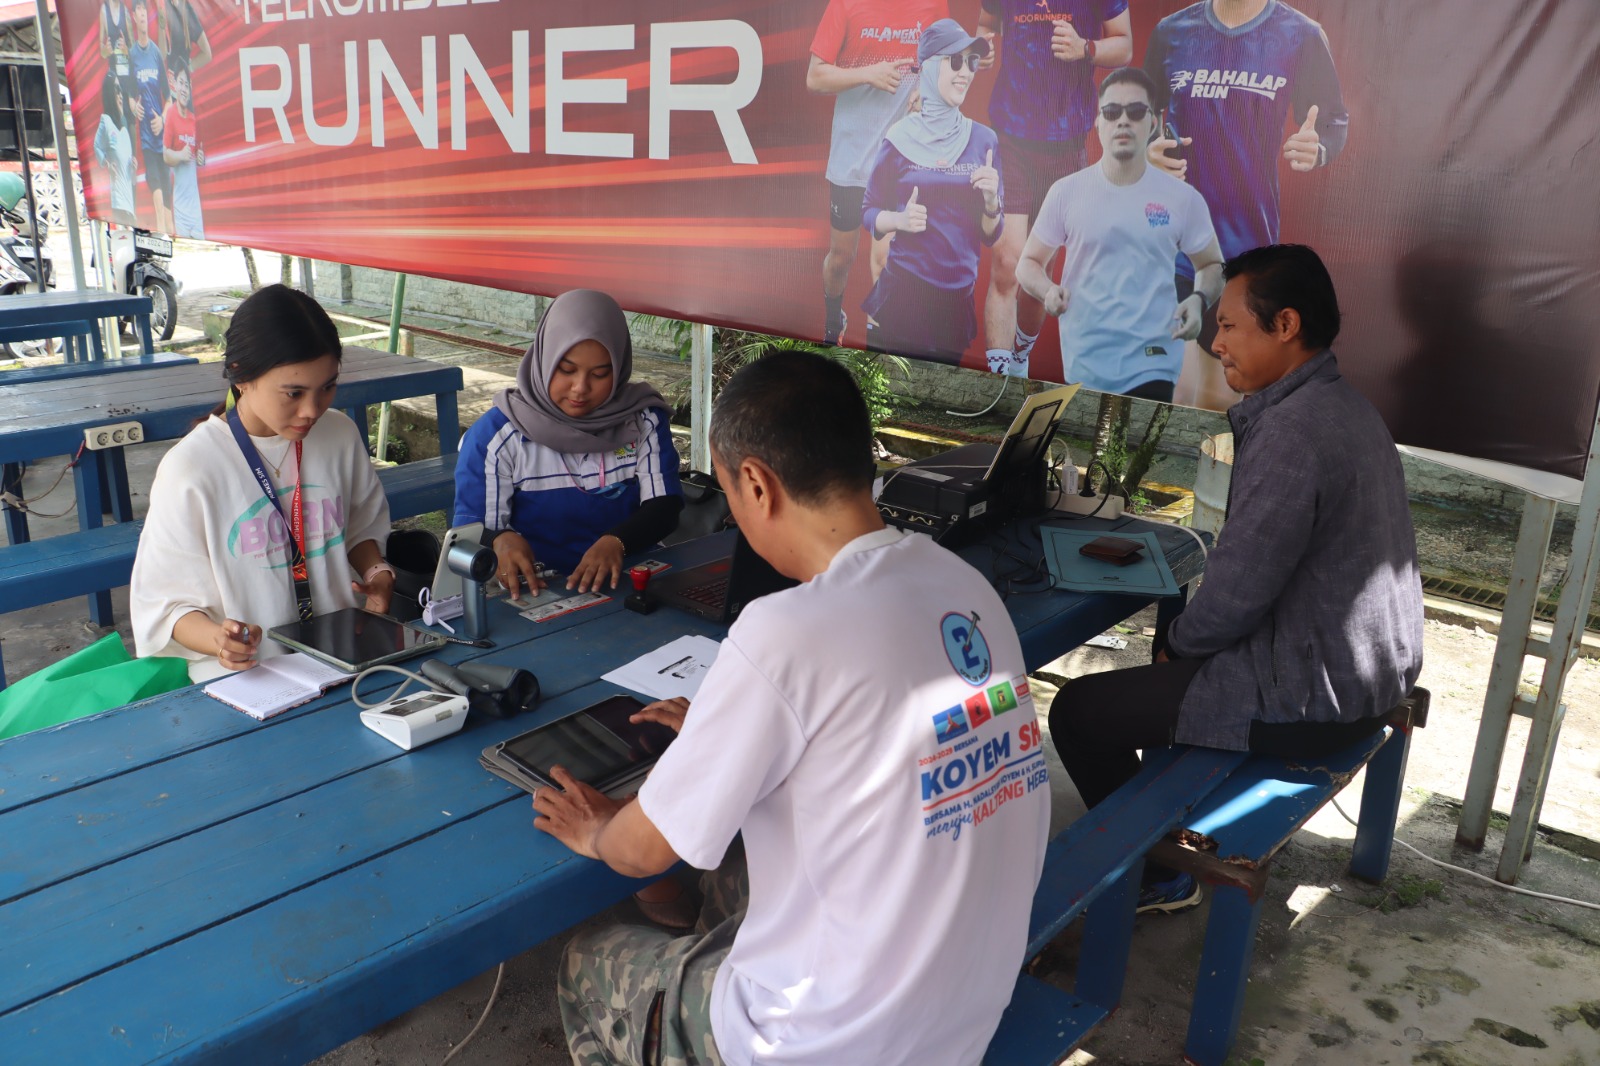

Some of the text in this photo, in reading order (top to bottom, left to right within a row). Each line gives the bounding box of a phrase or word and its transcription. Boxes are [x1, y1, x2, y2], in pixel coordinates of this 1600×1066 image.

[861, 26, 919, 42] PALANGK
[238, 19, 763, 165] RUNNER
[1191, 84, 1229, 99] RUN
[1193, 69, 1287, 91] BAHALAP
[239, 495, 345, 555] BORN
[921, 732, 1010, 801] KOYEM
[924, 804, 962, 826] BERSAMA
[927, 813, 972, 841] menuju
[972, 780, 1024, 827] KALTENG
